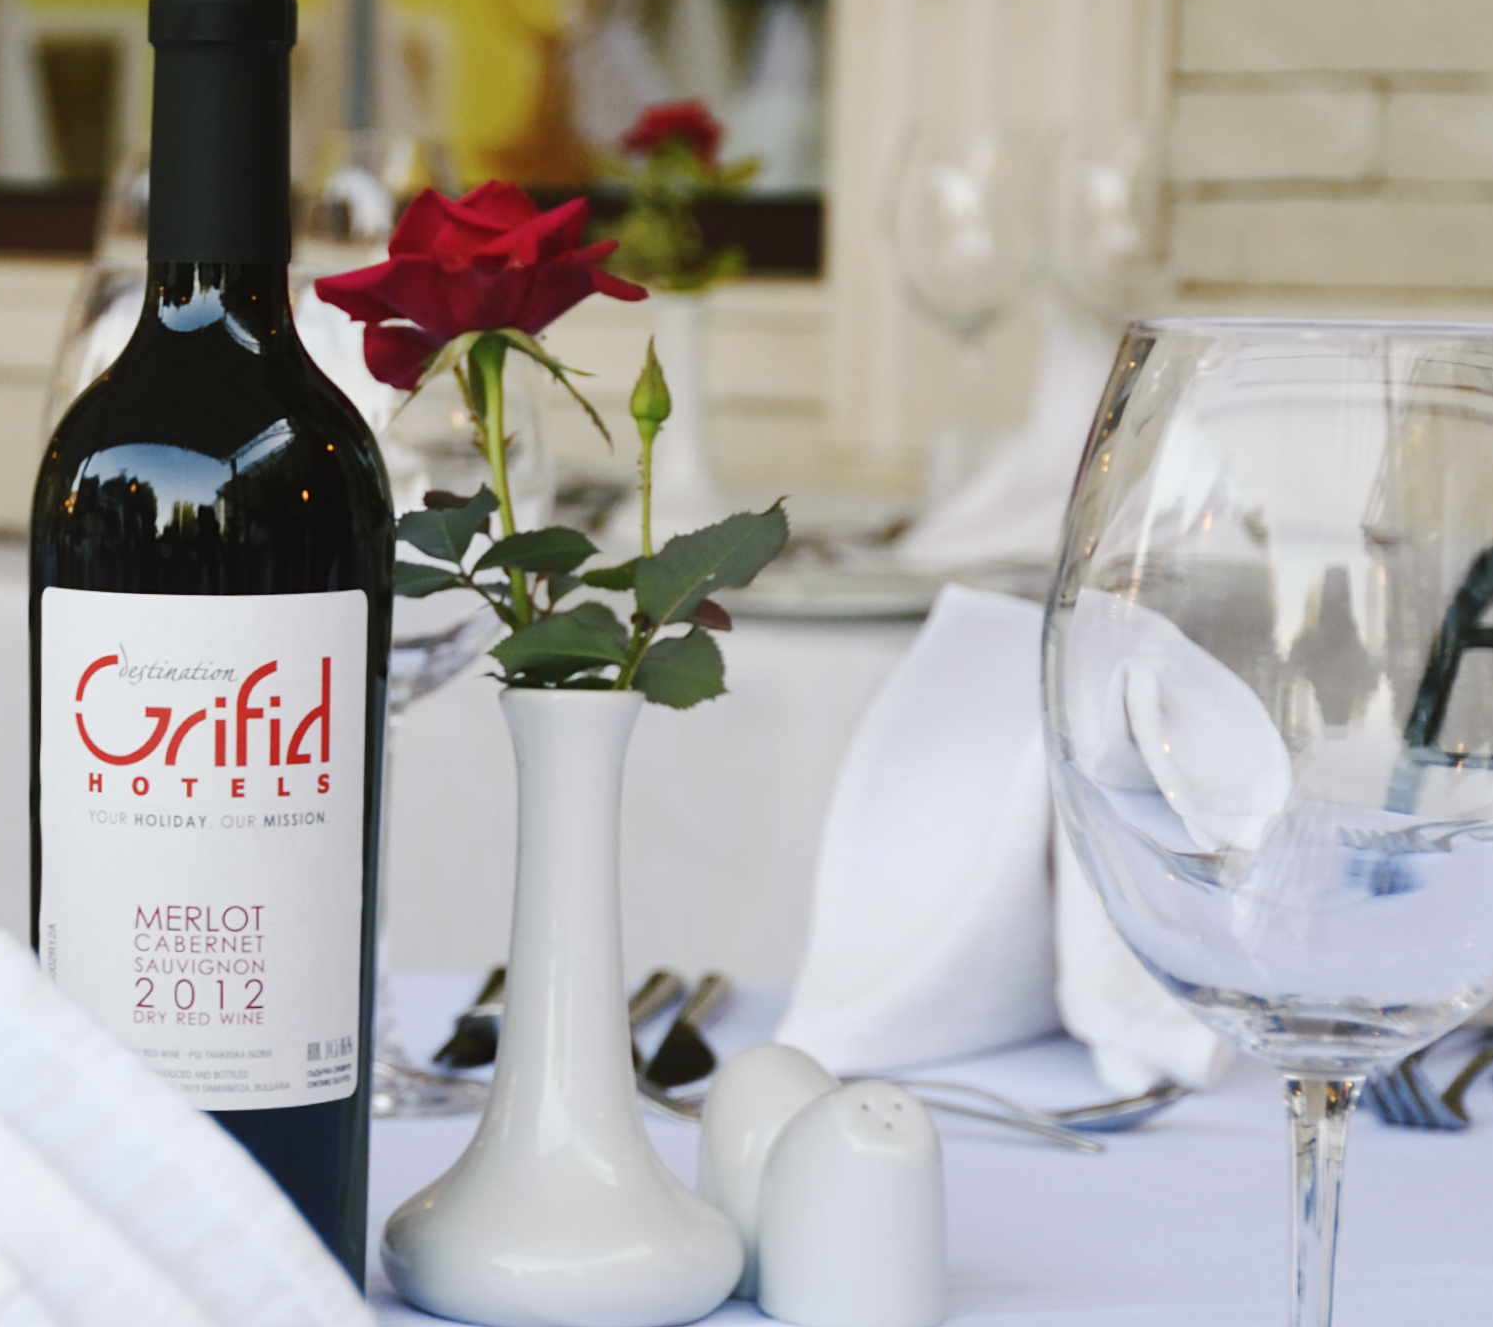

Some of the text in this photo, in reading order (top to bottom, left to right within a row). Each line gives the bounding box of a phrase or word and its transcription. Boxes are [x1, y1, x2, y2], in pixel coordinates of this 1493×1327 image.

[118, 642, 239, 685] destination
[75, 654, 331, 767] Grifid
[88, 773, 330, 798] HOTELS
[89, 809, 329, 829] YOUR HOLIDAY. OUR MISSION.
[134, 905, 265, 932] MERLOT
[134, 933, 265, 953] CABERNET
[134, 956, 265, 975] SAUVIGNON
[134, 977, 264, 1010] 2012
[133, 1010, 264, 1026] DRY RED WINE
